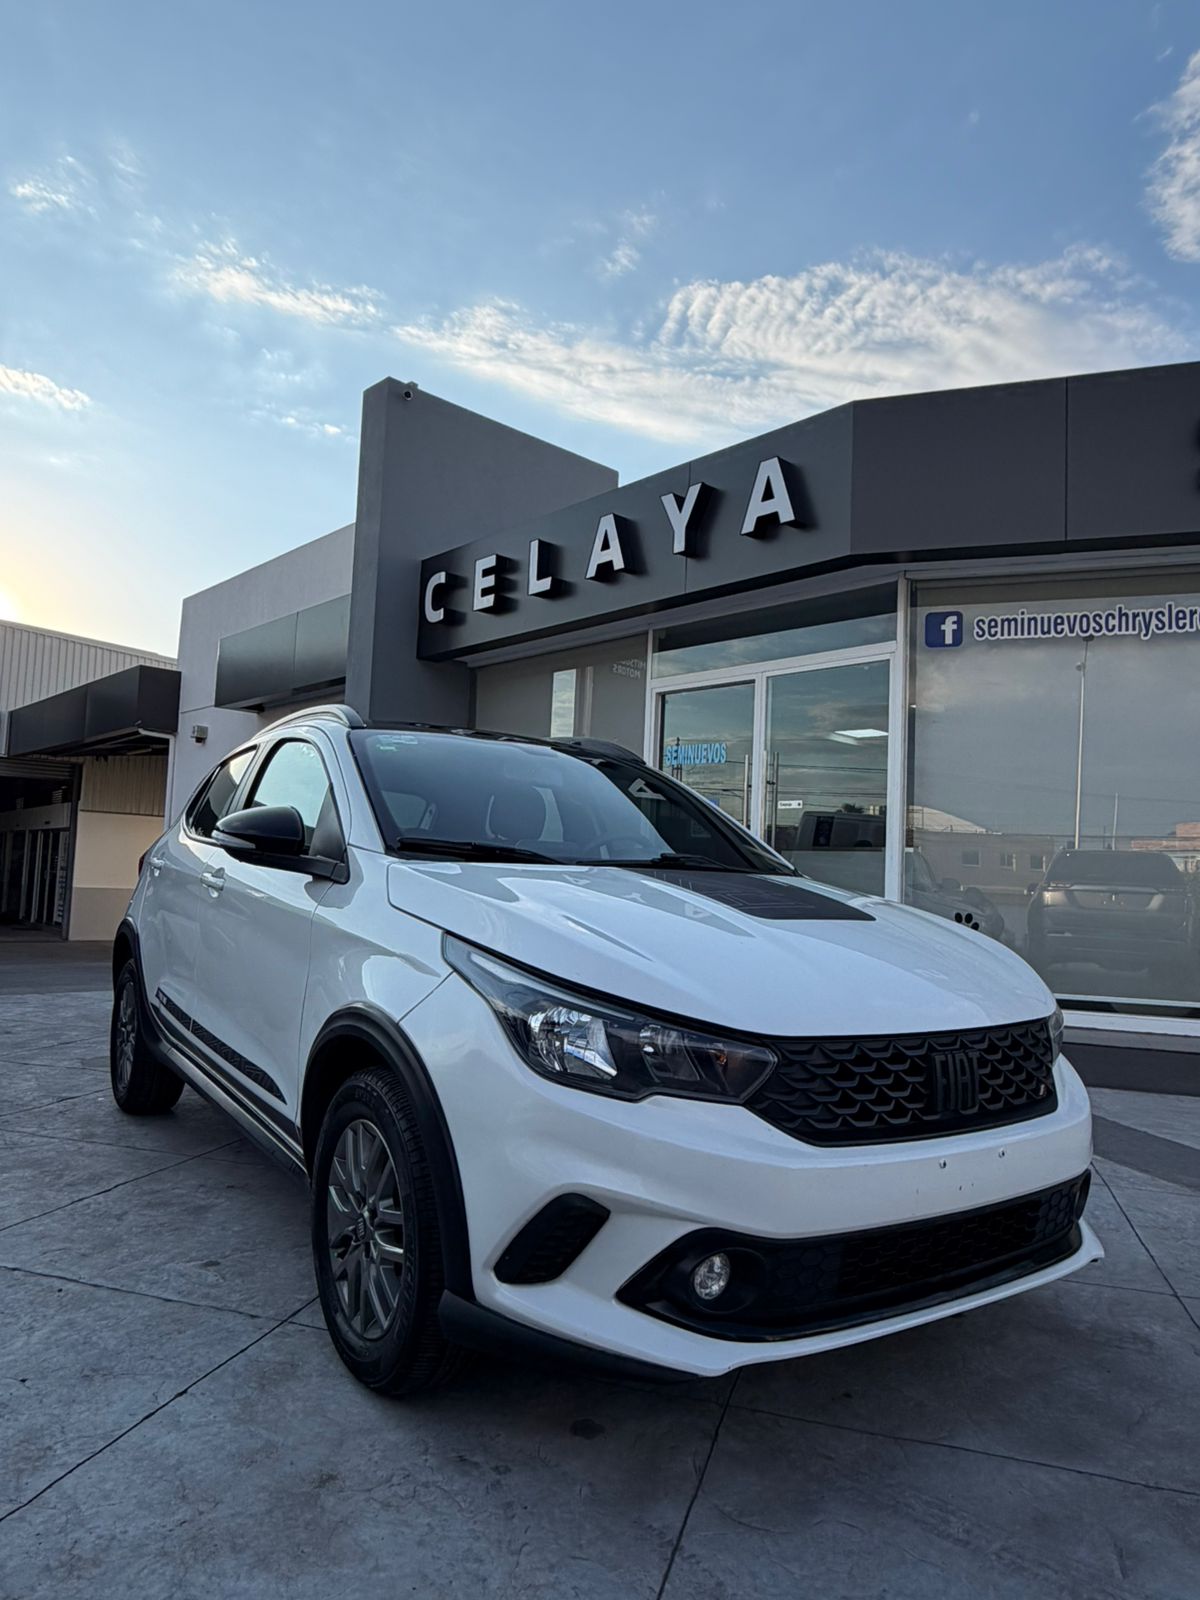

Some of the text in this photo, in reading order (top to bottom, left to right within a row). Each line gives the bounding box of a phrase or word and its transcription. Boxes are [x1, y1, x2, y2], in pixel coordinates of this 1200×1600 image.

[424, 456, 795, 623] CELAYA
[974, 602, 1200, 639] seminuevoschrysler
[665, 743, 727, 767] SEMINUEVOS
[933, 1051, 980, 1112] FIAT
